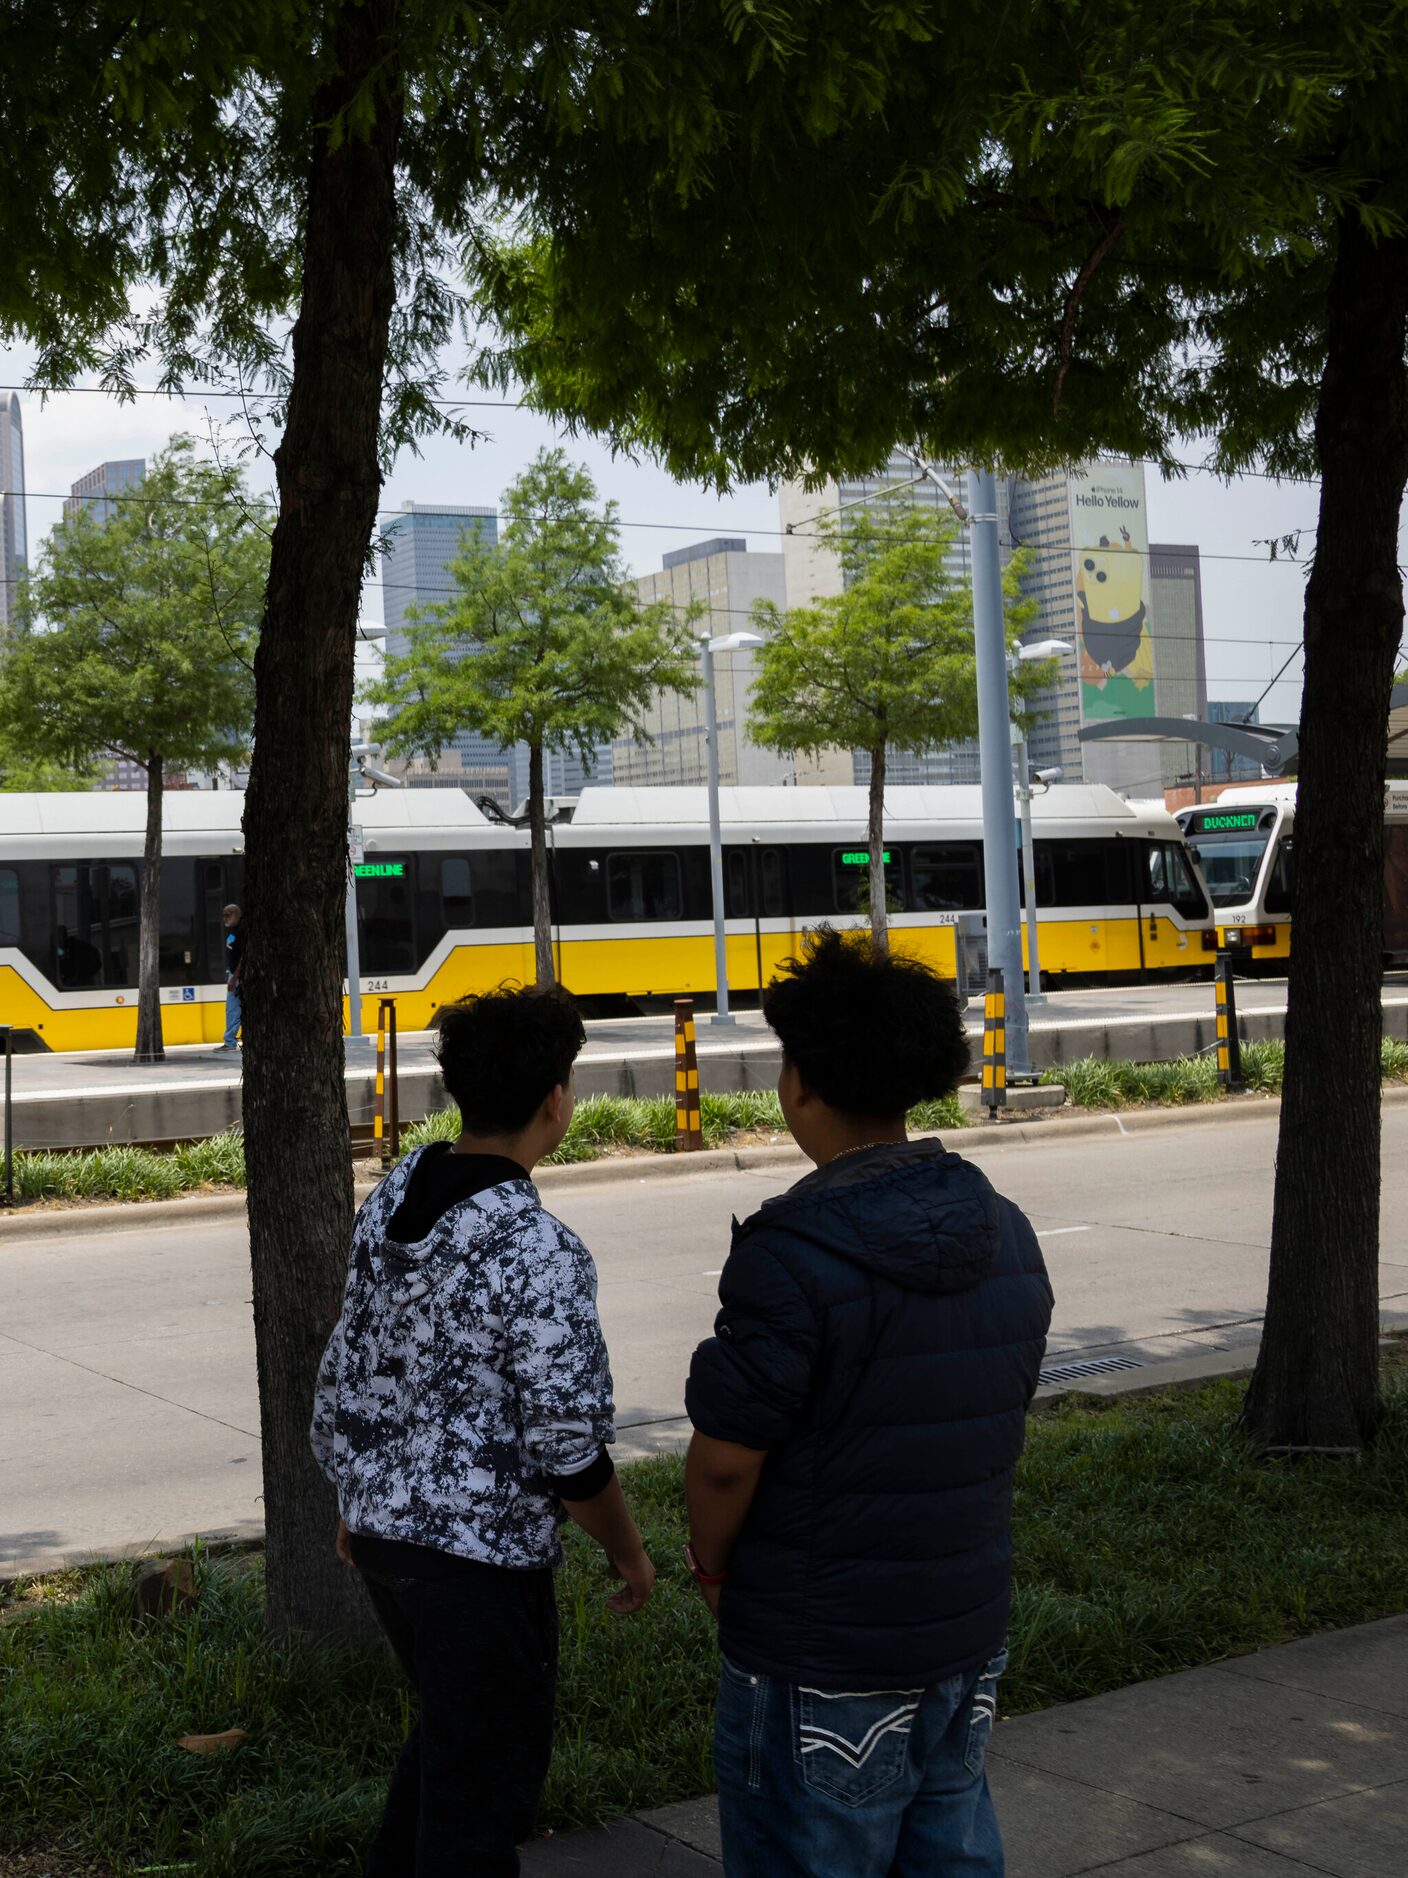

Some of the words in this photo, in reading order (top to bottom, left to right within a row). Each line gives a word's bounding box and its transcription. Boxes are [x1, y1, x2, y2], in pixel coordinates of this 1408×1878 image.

[1076, 494, 1104, 507] Hello
[1105, 495, 1139, 509] Yellow
[939, 914, 955, 924] 244
[1232, 915, 1246, 924] 192
[367, 980, 389, 992] 244
